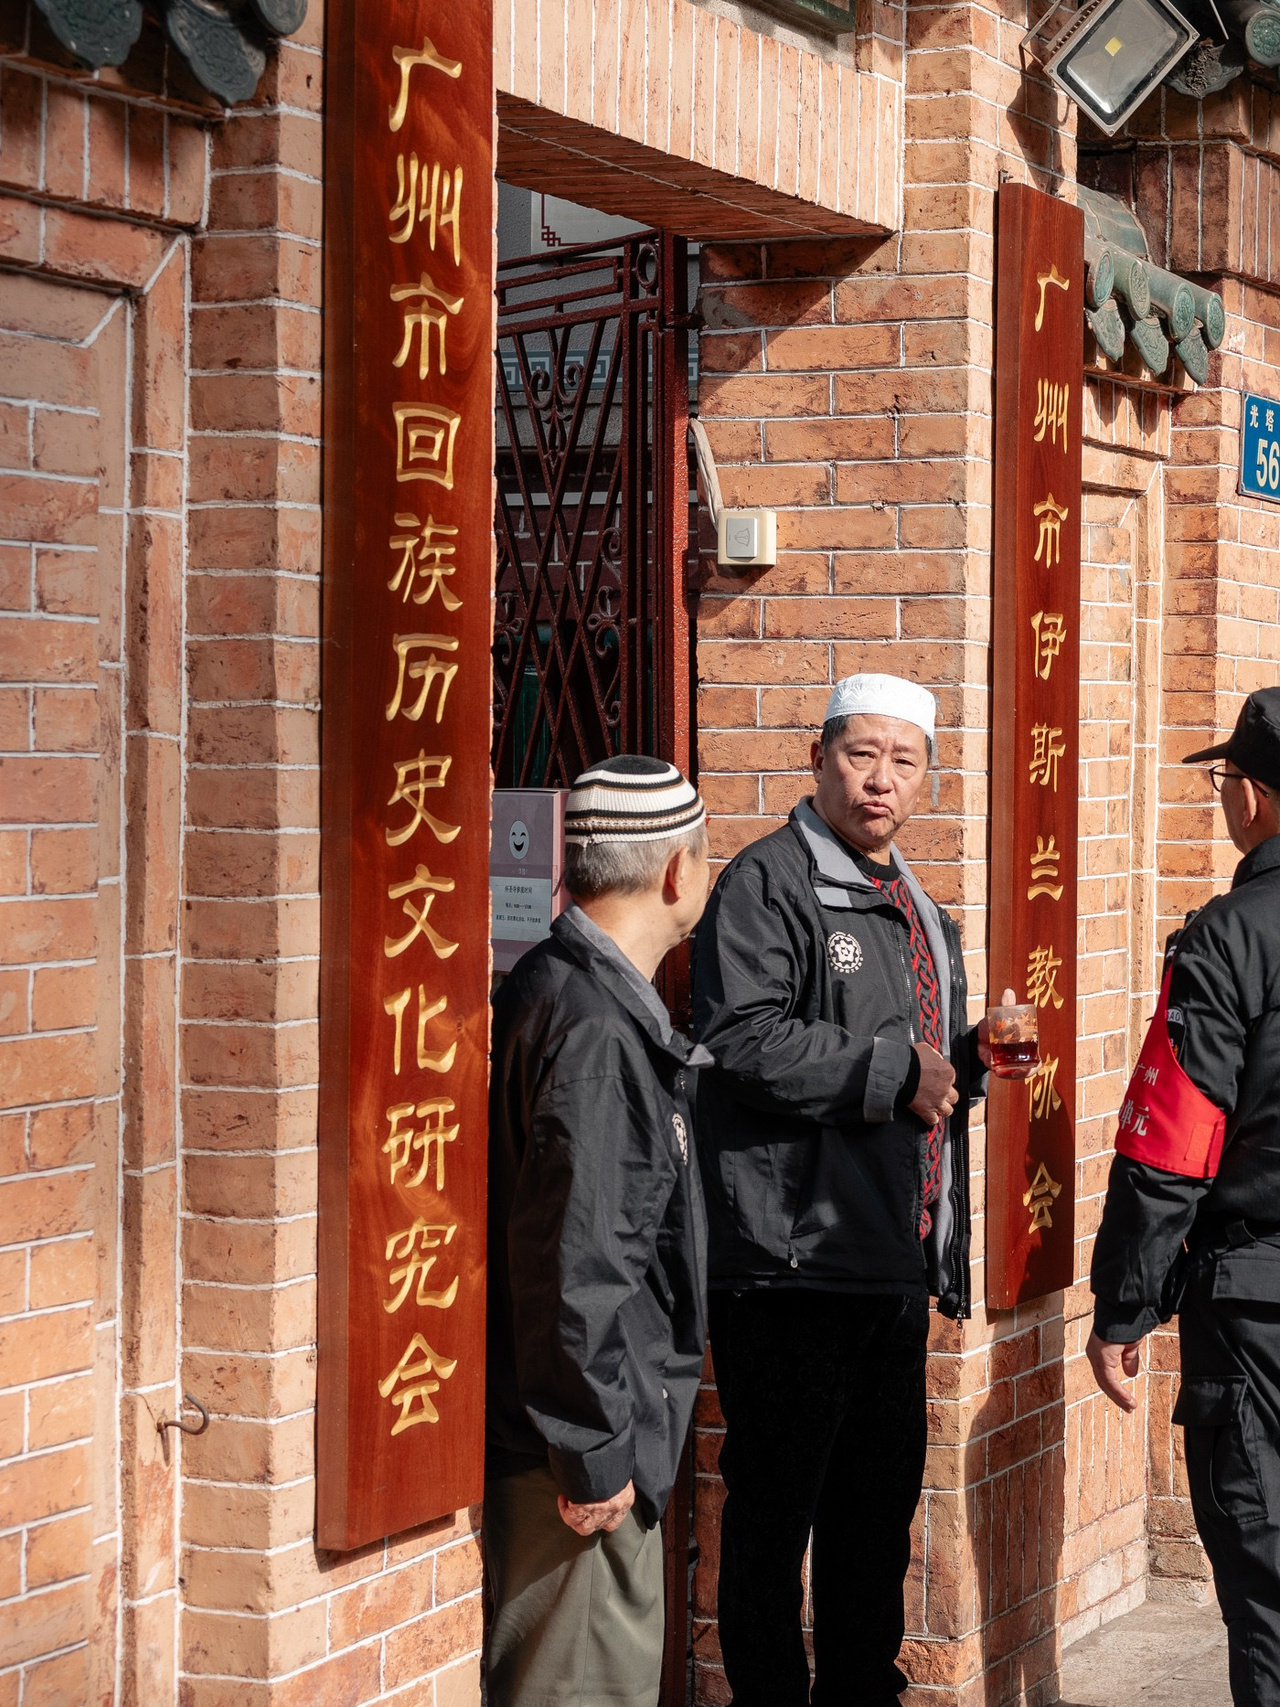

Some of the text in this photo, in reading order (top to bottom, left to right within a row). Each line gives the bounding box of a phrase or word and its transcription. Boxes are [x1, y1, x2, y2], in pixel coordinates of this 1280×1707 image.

[1255, 438, 1280, 490] 56
[377, 36, 466, 1437] 广州市回族历史文化研究会
[1022, 264, 1070, 1235] 广州市伊斯兰教协会
[1119, 1098, 1150, 1137] 单元
